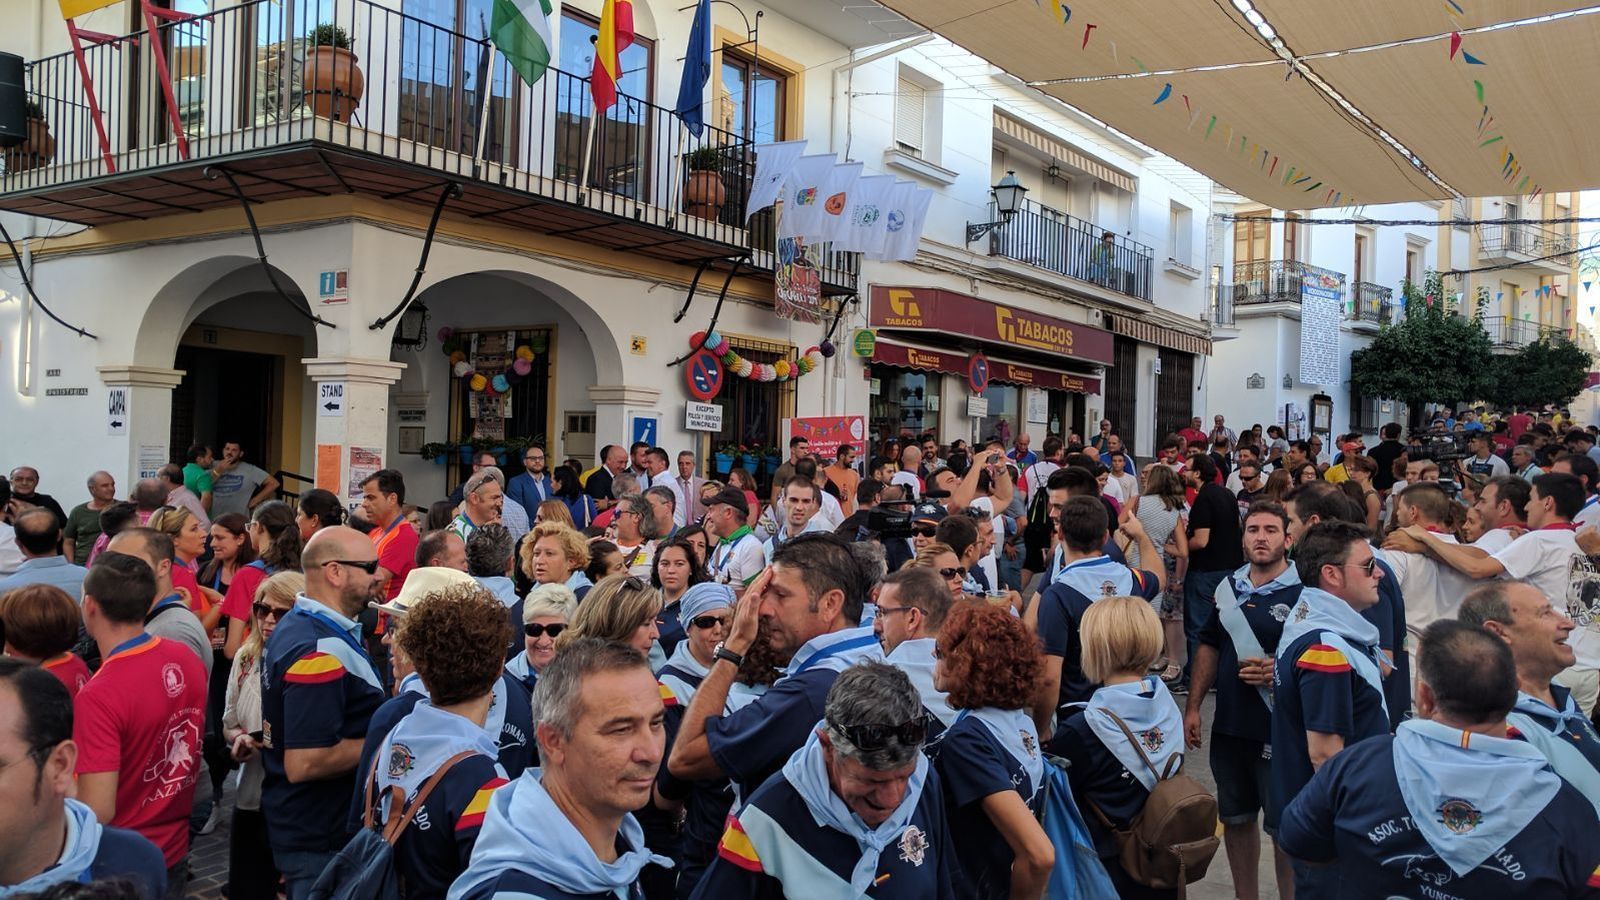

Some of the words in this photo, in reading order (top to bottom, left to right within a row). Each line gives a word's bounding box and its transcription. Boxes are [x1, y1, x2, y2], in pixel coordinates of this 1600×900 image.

[885, 318, 922, 326] TABACOS
[1017, 317, 1073, 346] TABACOS
[918, 354, 940, 363] TABACOS
[321, 384, 343, 398] STAND
[108, 390, 126, 415] CARPA
[696, 405, 715, 413] EXCEPTO
[691, 420, 717, 429] MUNICIPALES
